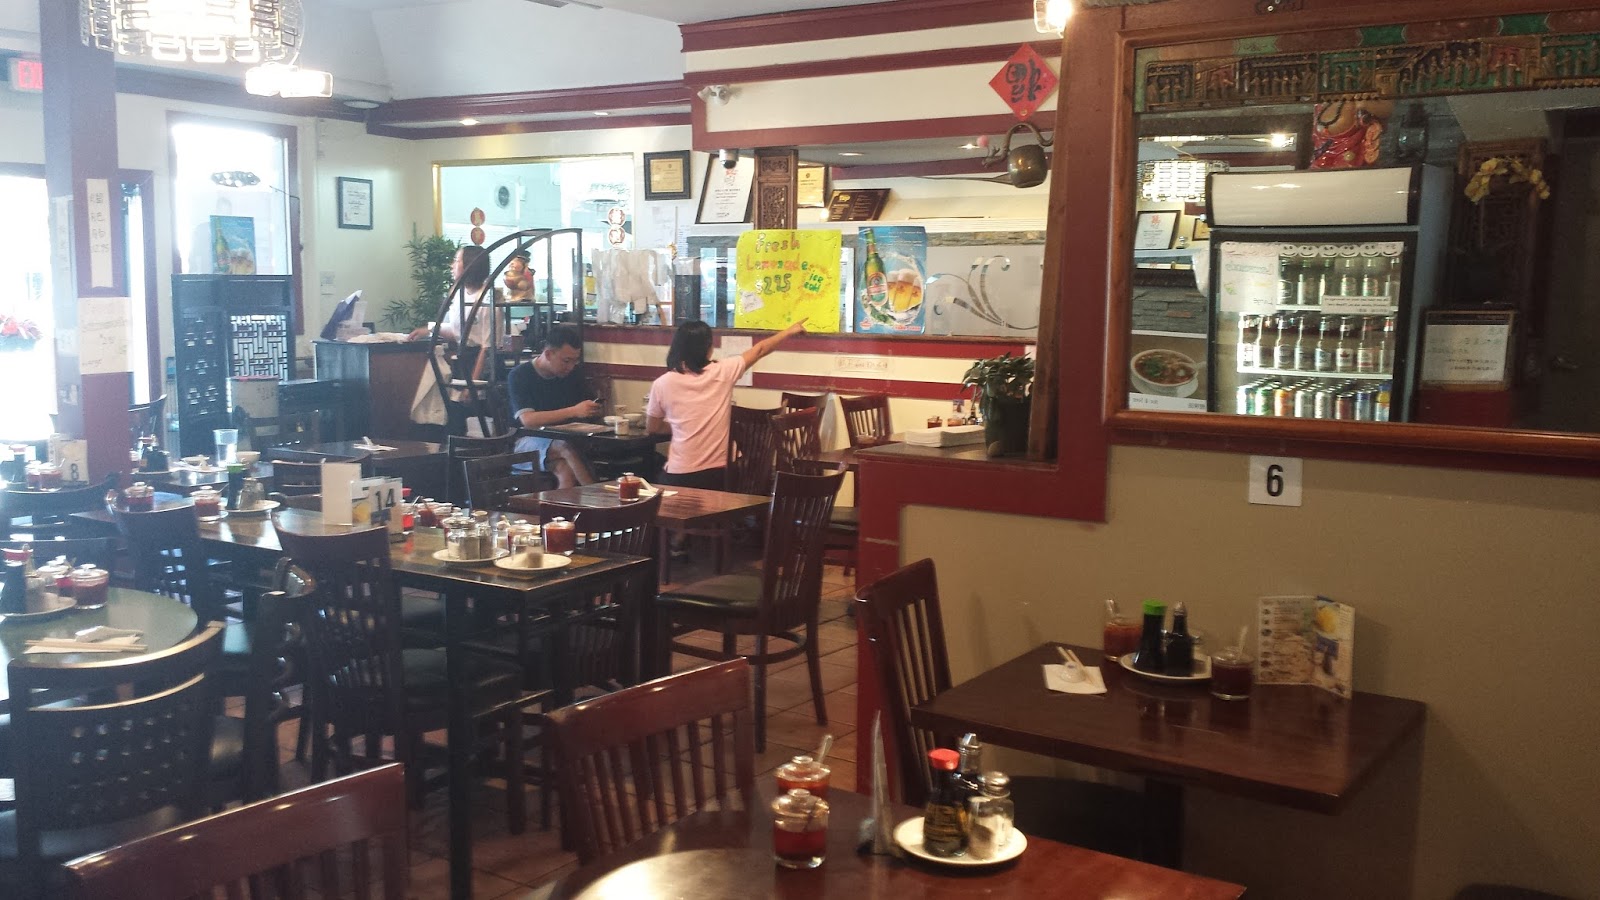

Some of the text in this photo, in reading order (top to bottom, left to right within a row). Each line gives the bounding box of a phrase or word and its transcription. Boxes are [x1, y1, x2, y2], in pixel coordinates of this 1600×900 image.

[755, 232, 800, 253] Fresh
[746, 253, 808, 271] Lemonade
[755, 273, 792, 295] $2.95
[70, 463, 79, 481] 8
[1267, 464, 1284, 497] 6
[375, 488, 396, 512] 14
